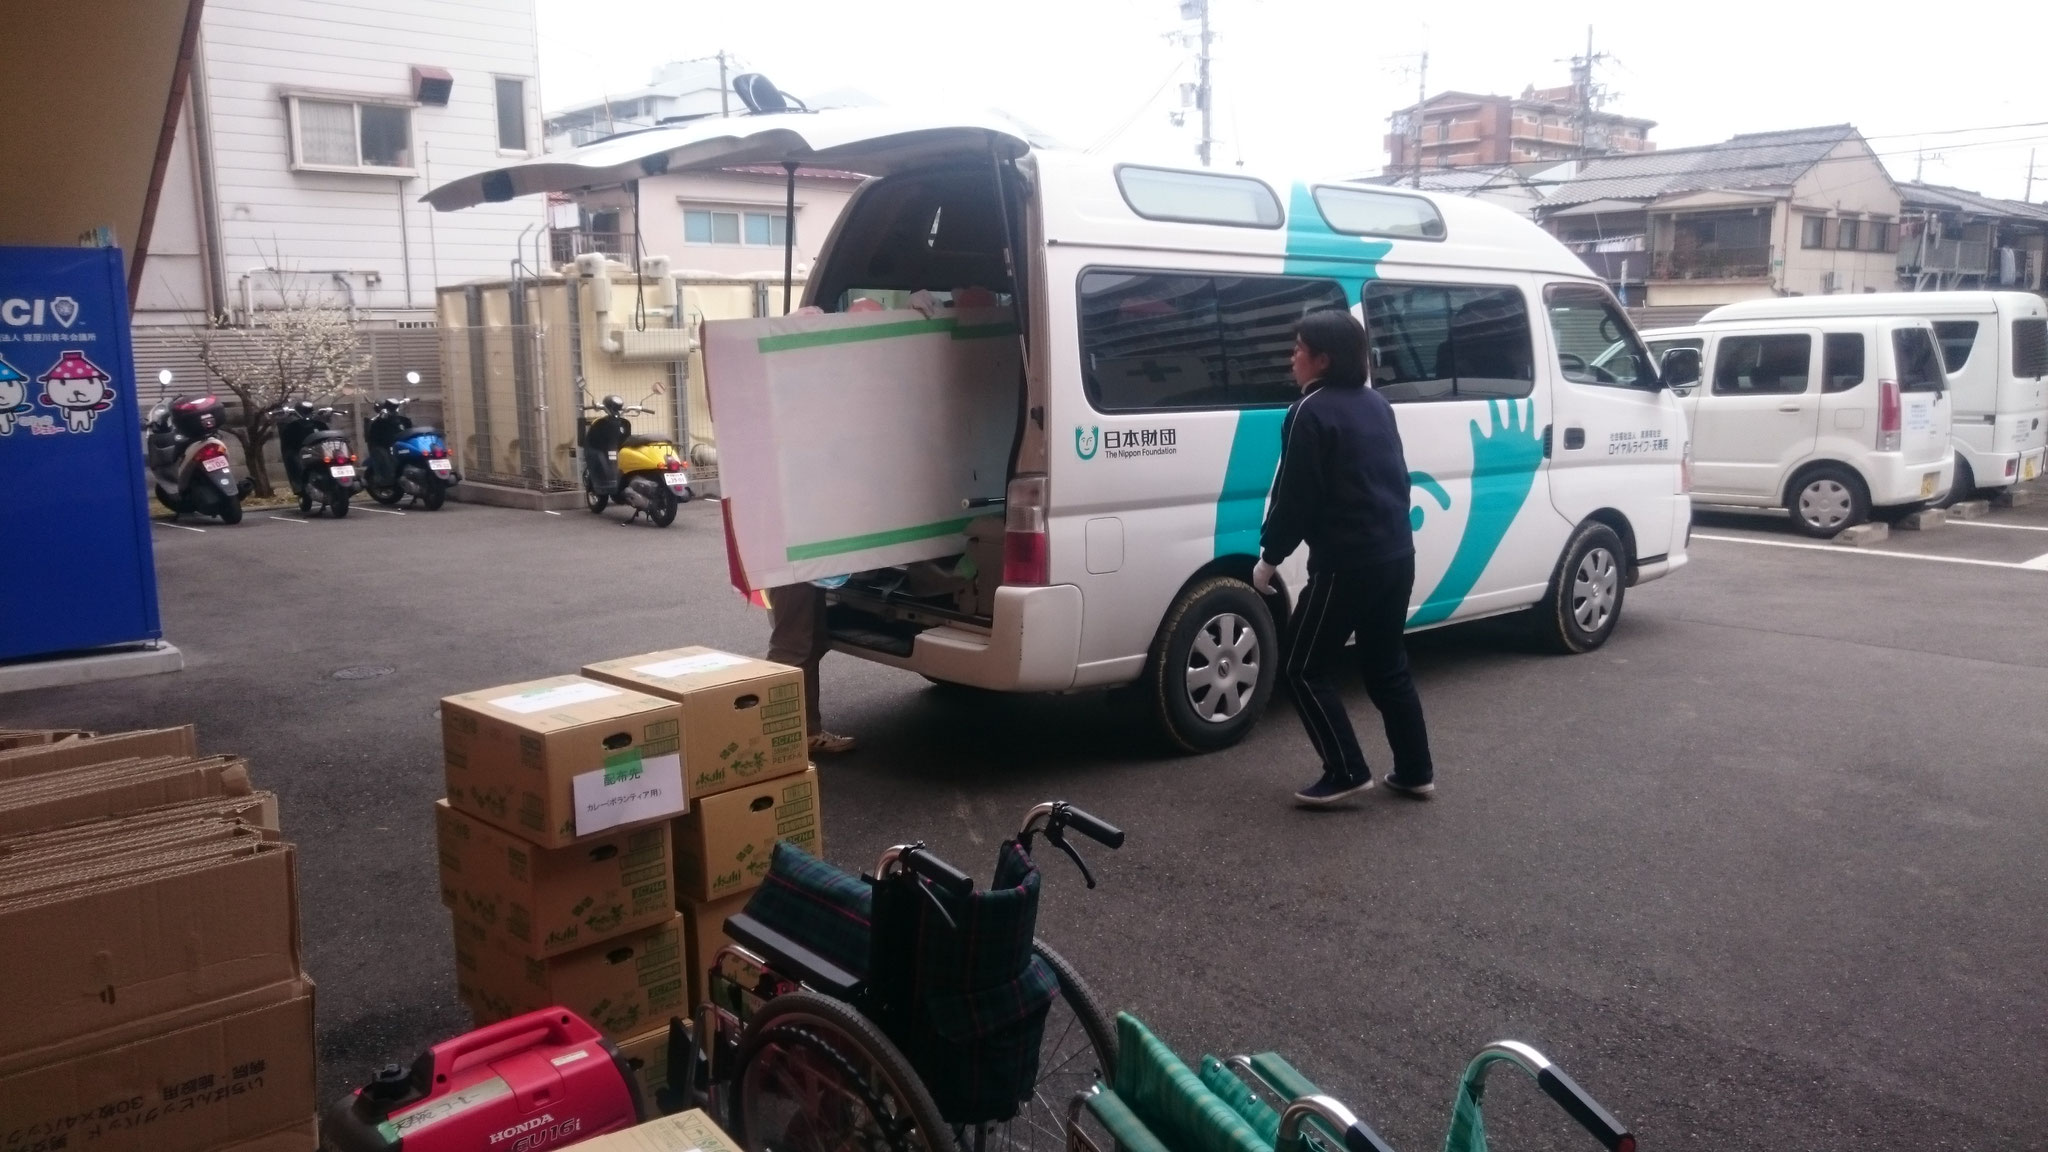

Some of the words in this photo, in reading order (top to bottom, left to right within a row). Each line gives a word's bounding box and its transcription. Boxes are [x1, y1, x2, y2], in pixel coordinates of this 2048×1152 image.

[1104, 428, 1176, 449] 日本財団
[1105, 450, 1117, 459] The
[1119, 449, 1141, 459] Nippon
[1142, 447, 1177, 457] Foundation
[603, 768, 641, 787] 配布先
[696, 767, 725, 785] Asahi
[489, 1113, 555, 1144] HONDA
